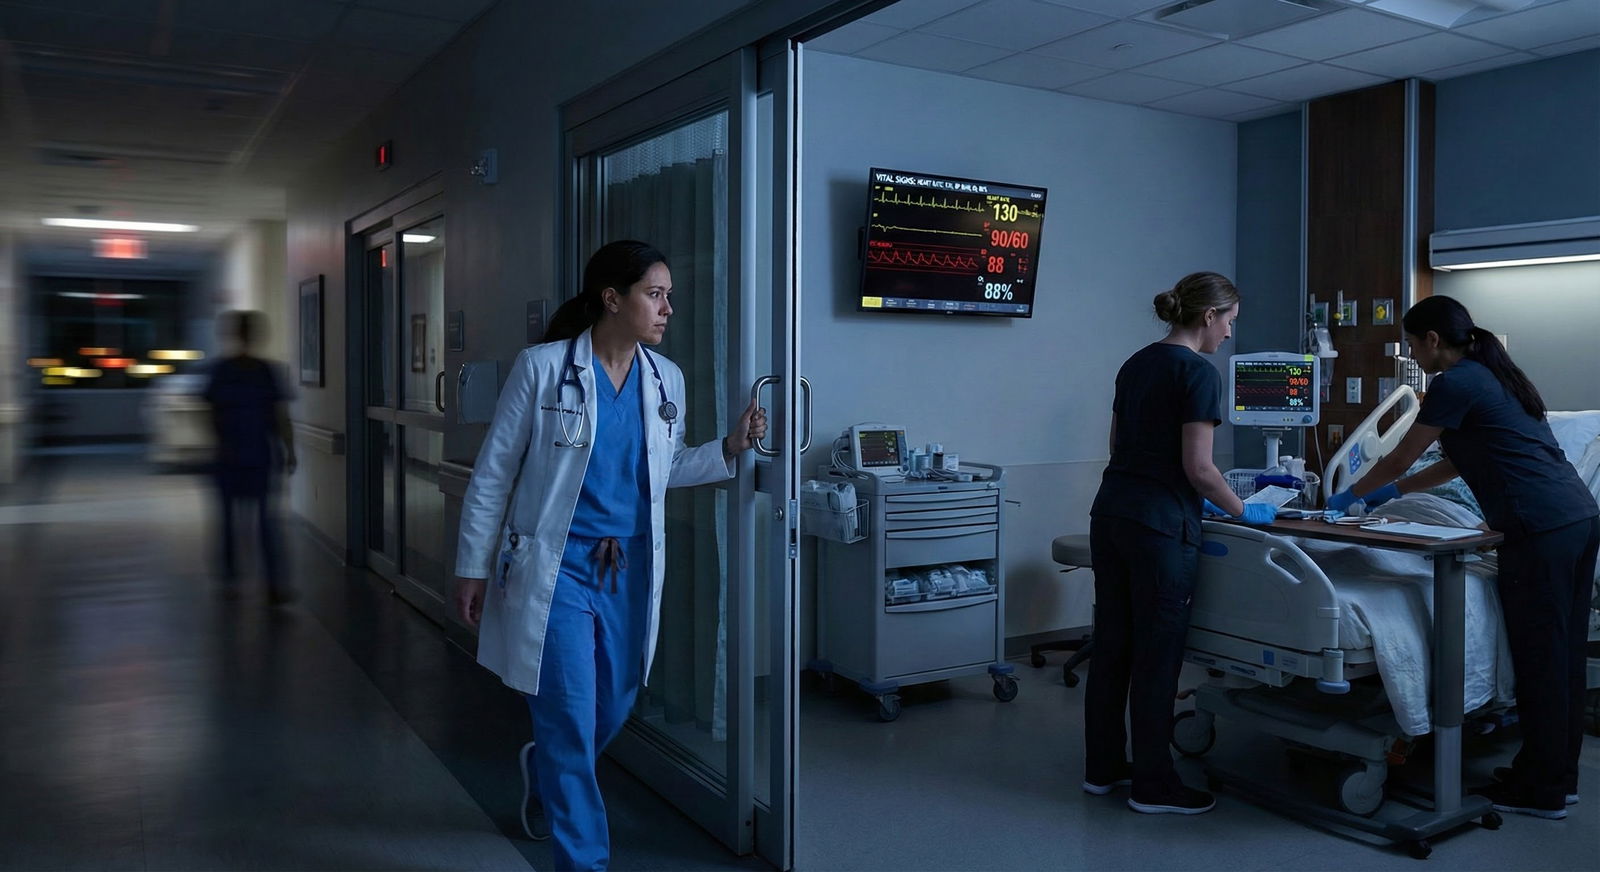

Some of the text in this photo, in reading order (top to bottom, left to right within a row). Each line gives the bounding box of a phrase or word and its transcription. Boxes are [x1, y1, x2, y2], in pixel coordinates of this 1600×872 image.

[875, 173, 895, 183] VITAL
[993, 203, 1018, 222] 130
[991, 229, 1029, 249] 90/60
[987, 256, 1005, 273] 88
[984, 282, 1013, 301] 88%
[1289, 367, 1302, 376] 130
[1289, 398, 1304, 407] 88%
